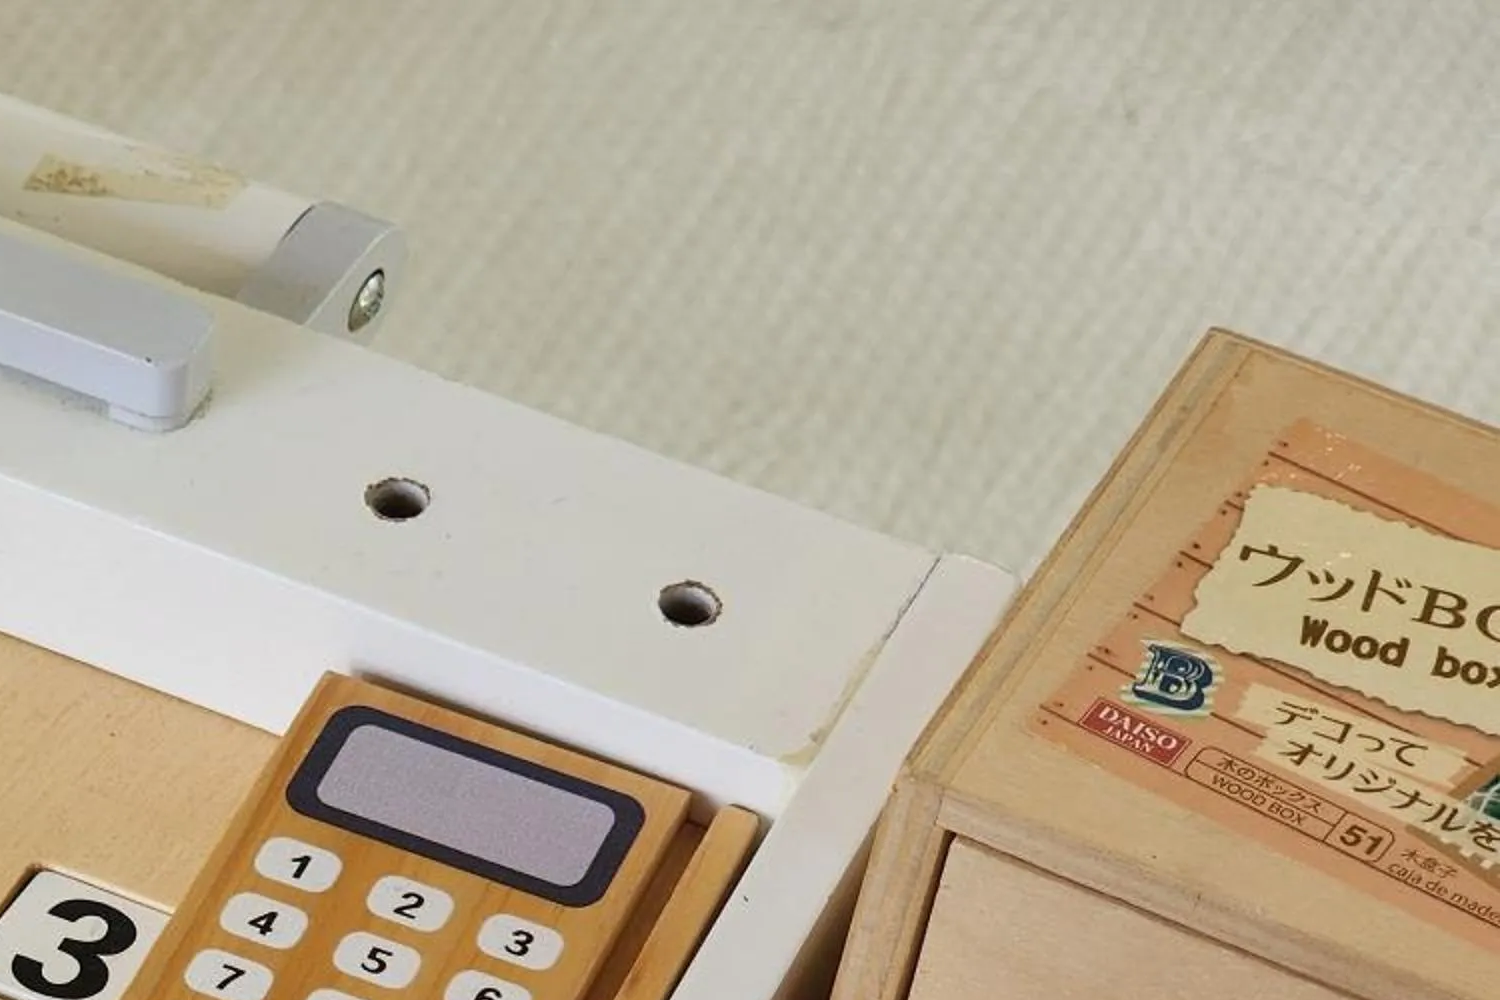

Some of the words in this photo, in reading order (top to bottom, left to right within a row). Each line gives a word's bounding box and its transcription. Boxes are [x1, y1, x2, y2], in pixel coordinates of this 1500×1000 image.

[1300, 615, 1410, 669] Wood
[1132, 643, 1213, 711] B
[1098, 706, 1178, 751] DAISO
[1105, 725, 1155, 754] JAPAN
[1275, 701, 1429, 767] デコって
[1211, 774, 1267, 806] WOOD
[1267, 801, 1306, 827] BOX
[1278, 740, 1500, 853] オリジナルを
[1339, 824, 1384, 856] 51
[291, 854, 312, 880] 1
[393, 891, 425, 920] 2
[503, 929, 535, 957] 3
[1425, 879, 1449, 897] de
[11, 899, 137, 1000] 3
[247, 910, 279, 936] 4
[360, 946, 393, 975] 5
[215, 963, 247, 991] 7
